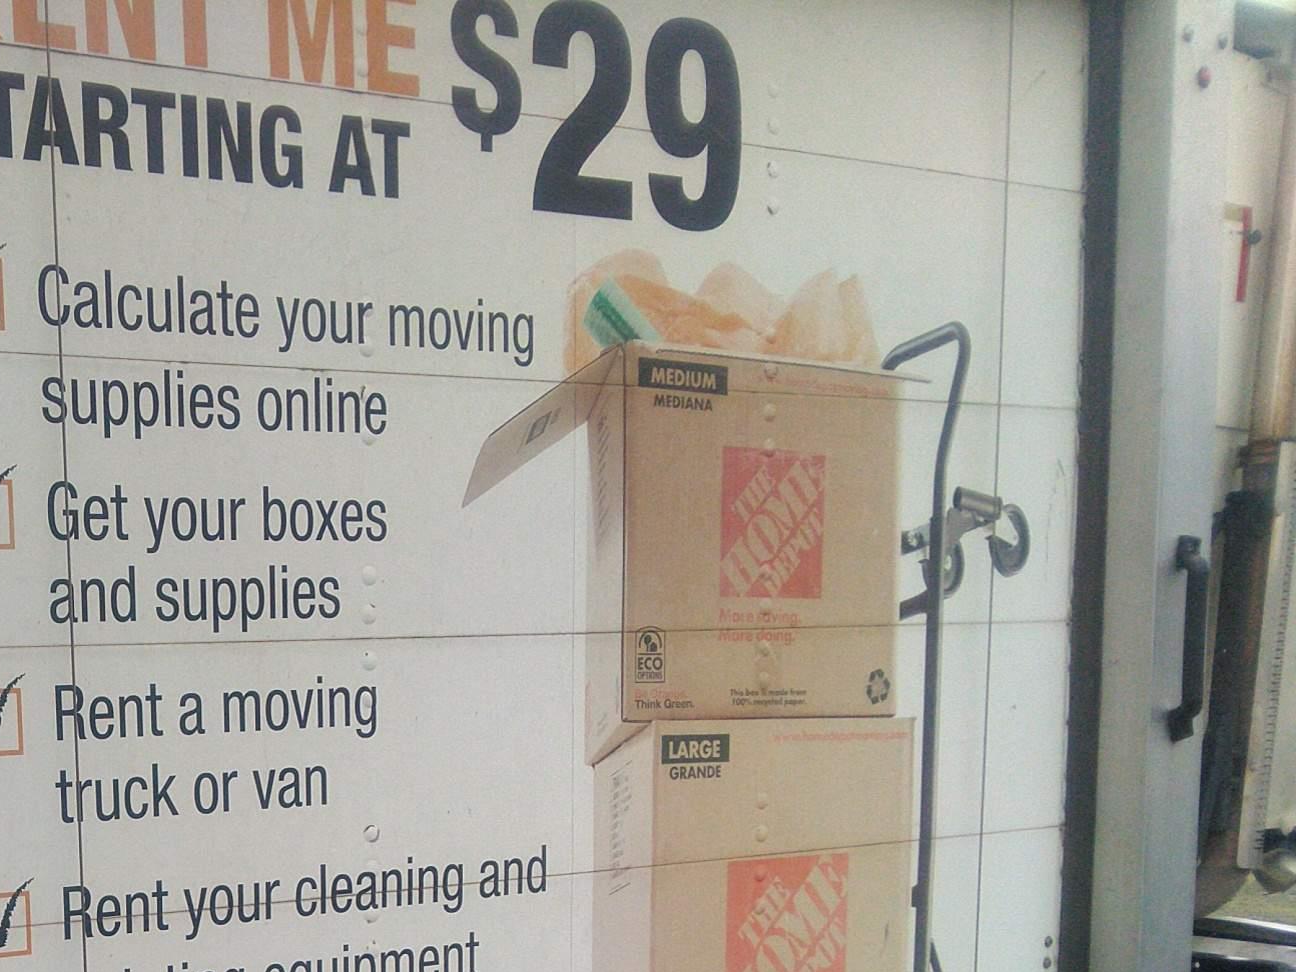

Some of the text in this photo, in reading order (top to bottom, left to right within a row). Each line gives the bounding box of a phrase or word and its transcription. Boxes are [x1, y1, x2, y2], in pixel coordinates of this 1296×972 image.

[267, 0, 421, 97] ME
[449, 0, 743, 233] $29
[328, 114, 411, 199] AT
[37, 263, 536, 368] Calculate your moving
[41, 369, 389, 439] supplies online
[650, 365, 717, 391] MEDIUM
[653, 393, 714, 412] MEDIANA
[47, 480, 388, 554] Get your boxes
[49, 564, 341, 633] and supplies
[637, 656, 664, 671] ECO
[55, 676, 379, 742] Rent a moving
[634, 699, 662, 710] Think
[668, 739, 722, 760] LARGE
[669, 764, 722, 781] GRANDE
[54, 763, 329, 824] truck or van
[62, 844, 549, 941] Rent your cleaning and
